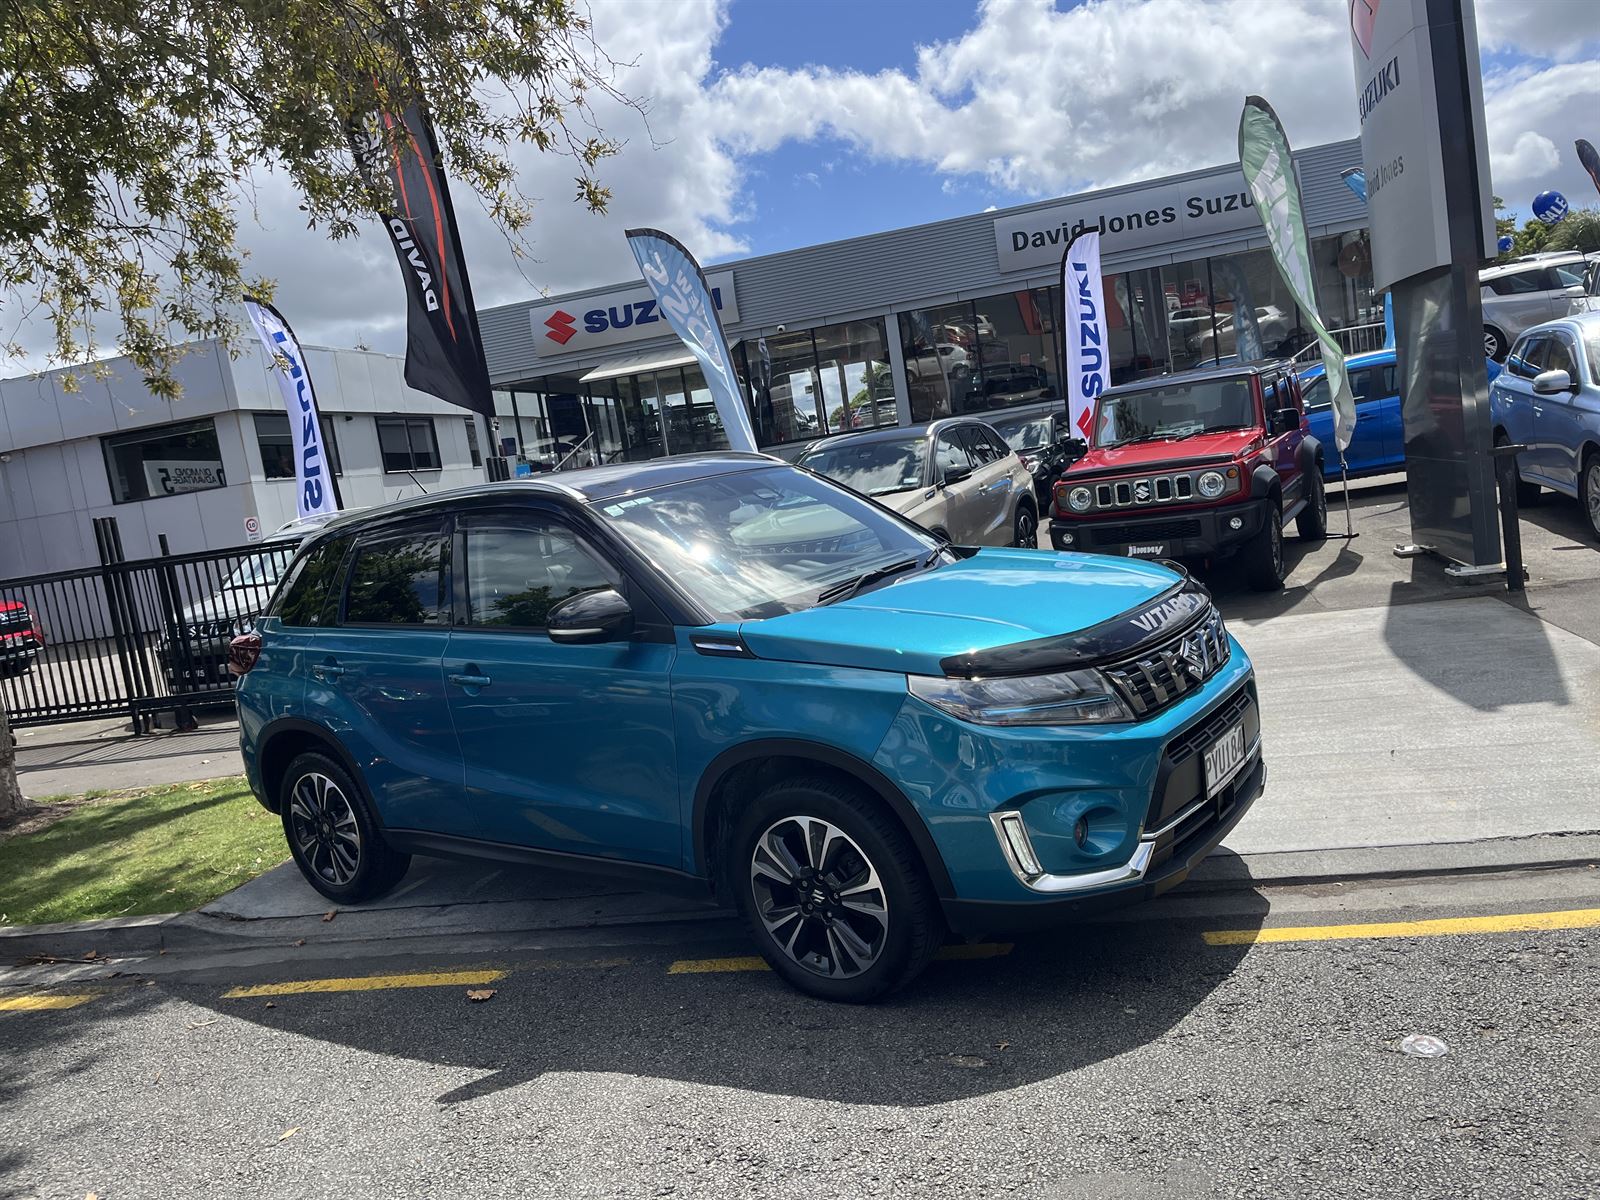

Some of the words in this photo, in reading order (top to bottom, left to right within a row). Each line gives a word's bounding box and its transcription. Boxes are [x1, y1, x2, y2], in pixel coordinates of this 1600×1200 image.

[1012, 218, 1085, 252] David
[1098, 205, 1176, 236] Jones
[1540, 197, 1567, 223] SALE
[584, 287, 723, 334] SUZI
[1072, 263, 1102, 398] SUZUKI
